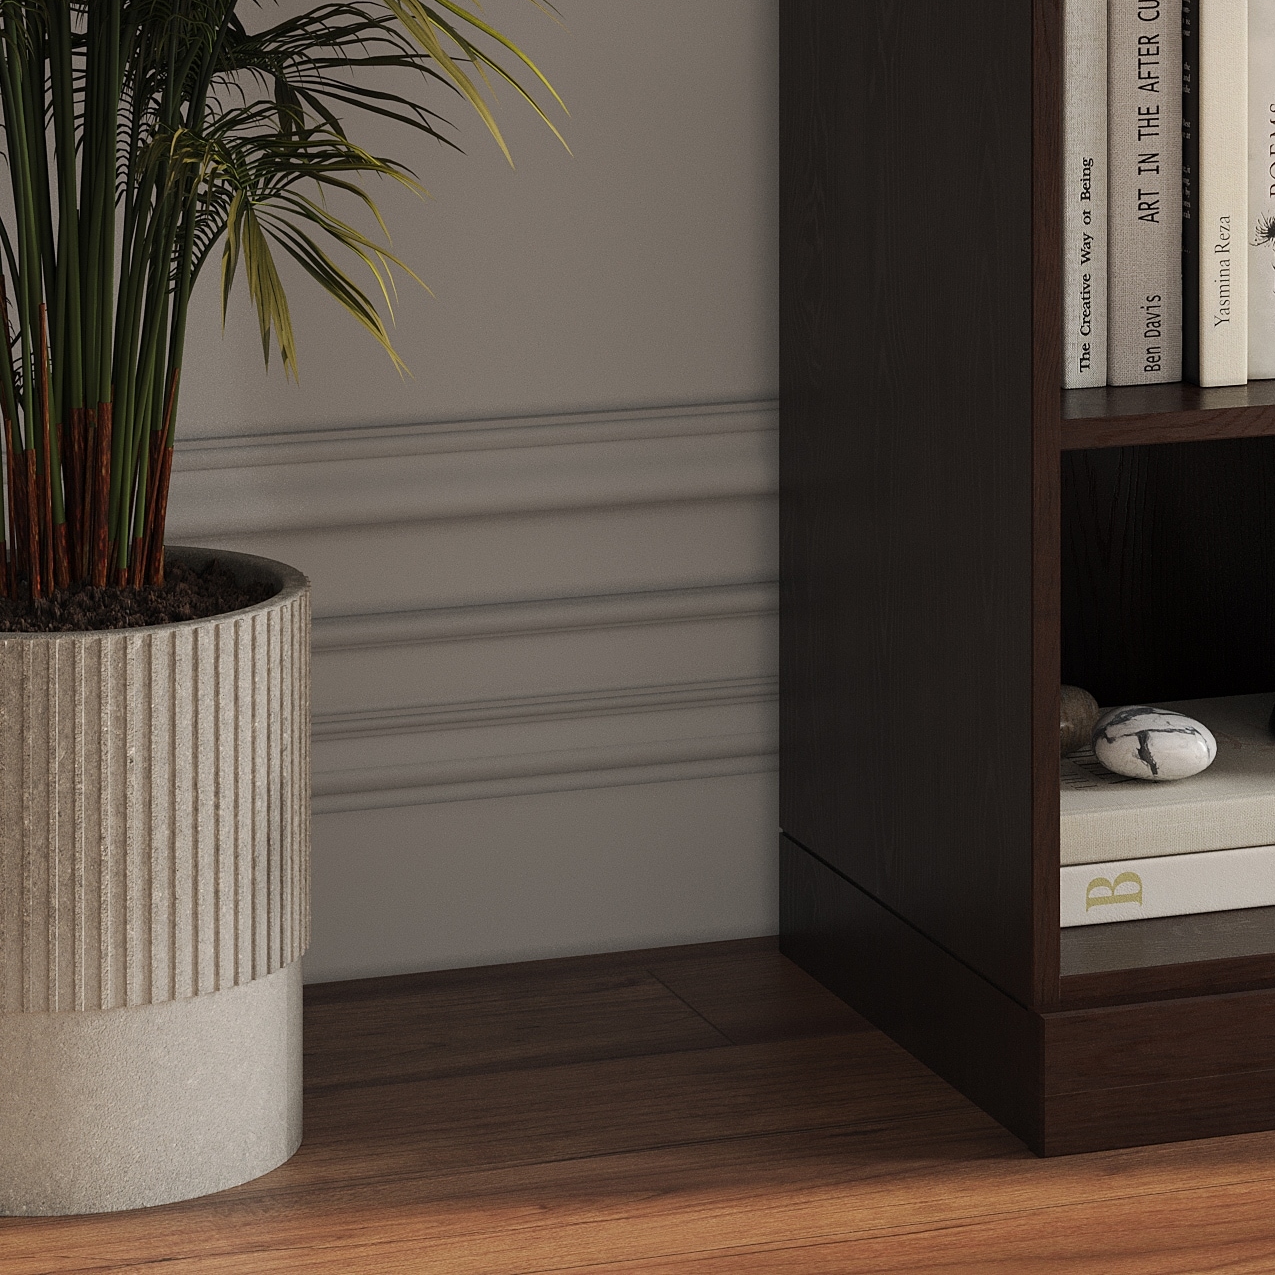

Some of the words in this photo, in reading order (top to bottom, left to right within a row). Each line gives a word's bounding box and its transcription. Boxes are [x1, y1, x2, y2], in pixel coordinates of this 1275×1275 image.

[1138, 33, 1160, 93] AFTER
[1138, 104, 1160, 142] THE
[1080, 157, 1094, 202] Being
[1138, 152, 1160, 176] IN
[1138, 188, 1160, 224] ART
[1080, 231, 1094, 266] Way
[1214, 216, 1231, 253] Reza
[1080, 273, 1092, 336] Creative
[1214, 256, 1231, 327] Yasmina
[1143, 294, 1162, 338] Davis
[1079, 342, 1091, 373] The
[1143, 344, 1162, 373] Ben
[1085, 871, 1143, 913] B
